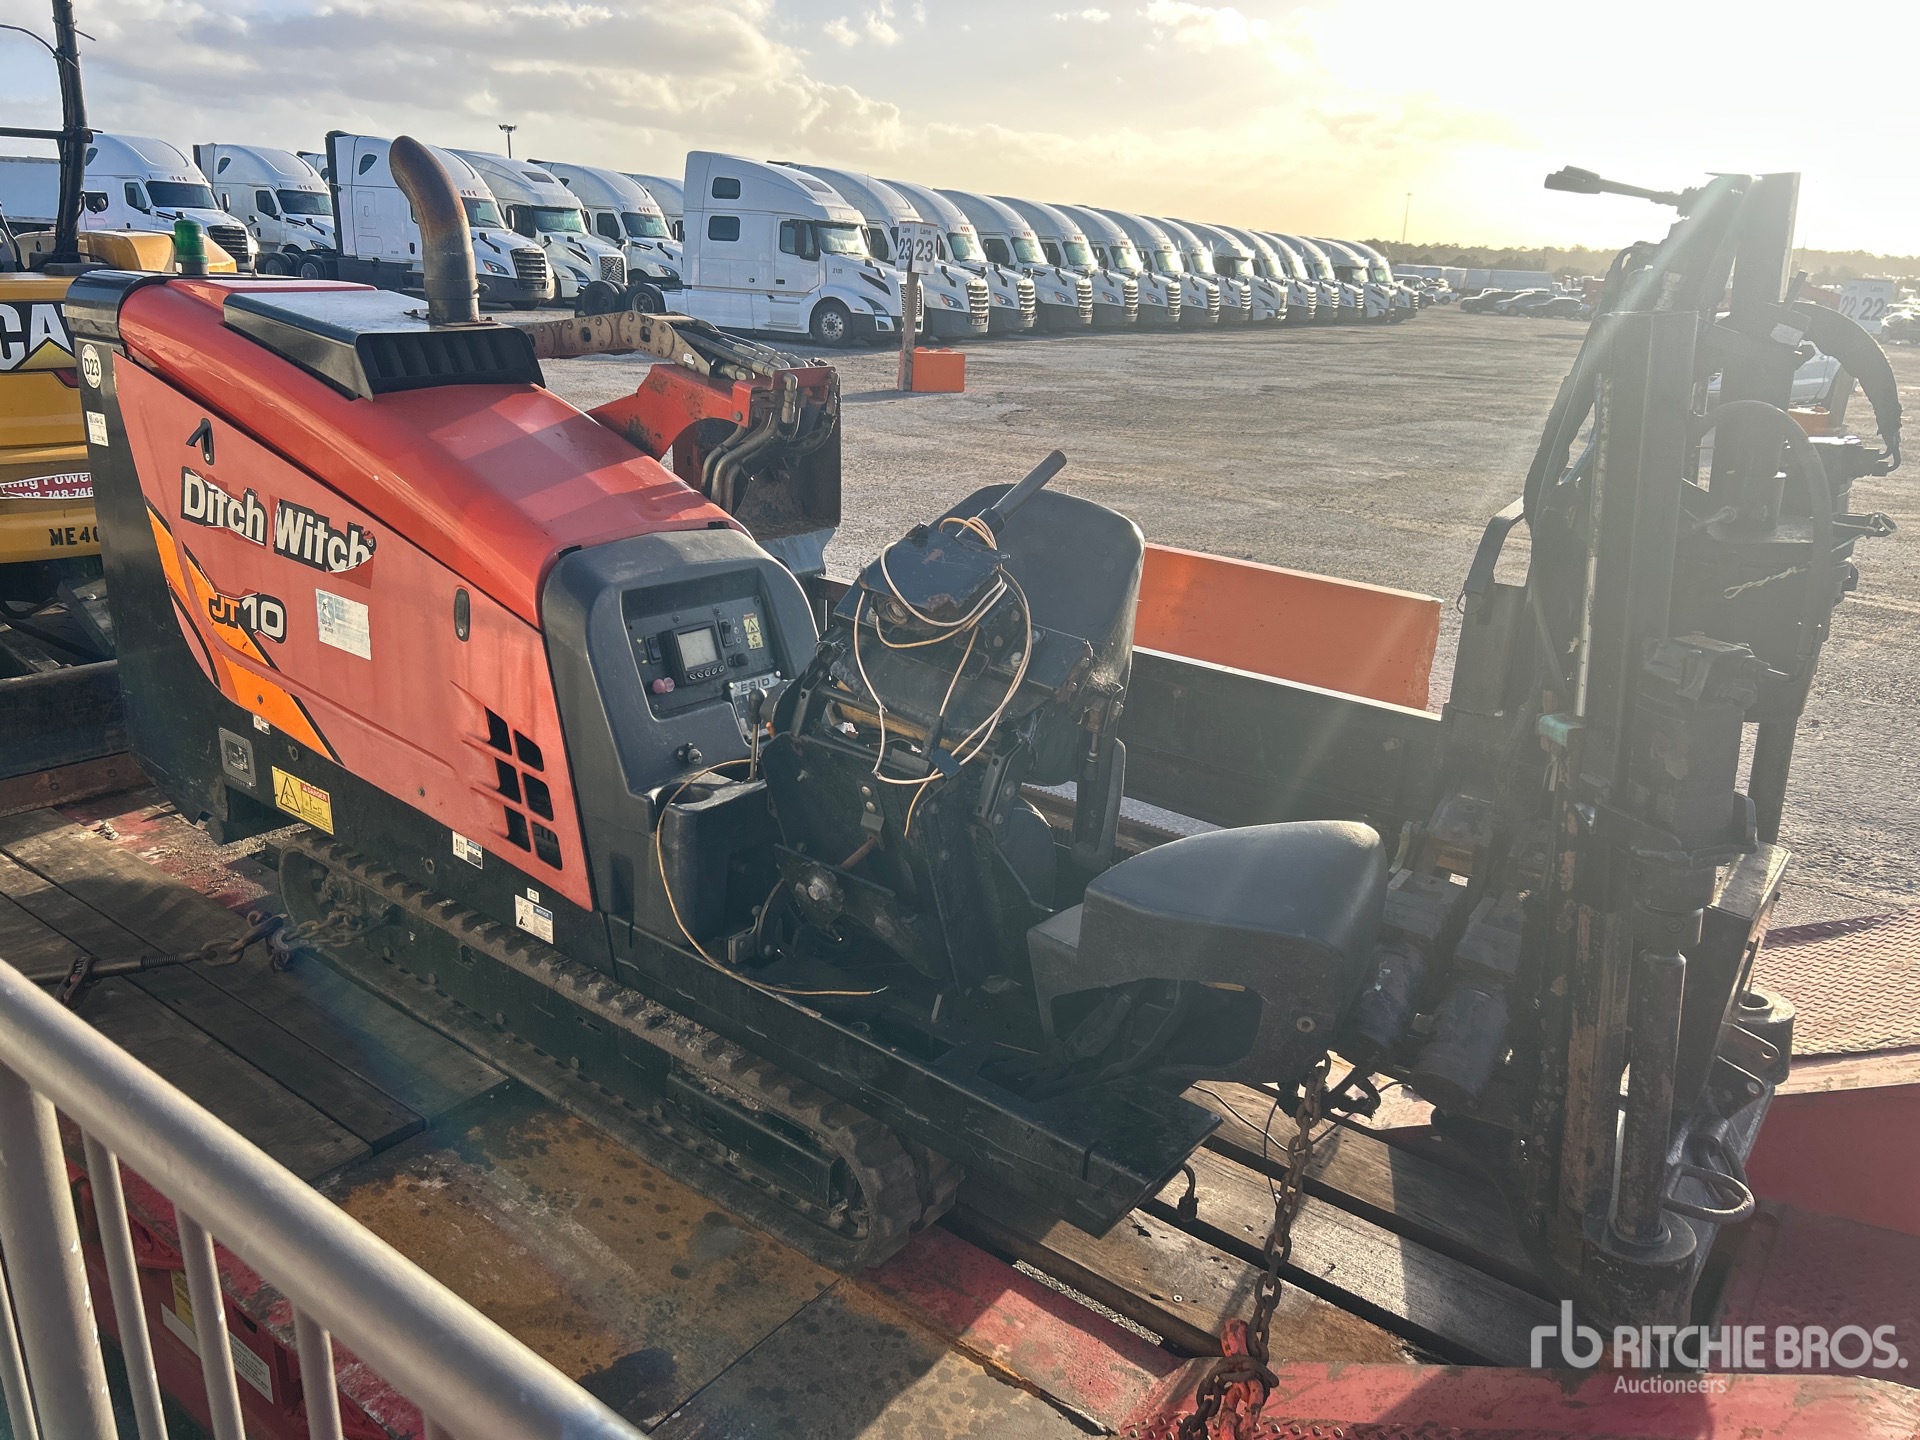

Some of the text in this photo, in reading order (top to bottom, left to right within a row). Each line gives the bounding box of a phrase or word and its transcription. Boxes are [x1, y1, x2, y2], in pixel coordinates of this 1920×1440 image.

[920, 227, 932, 235] Lane
[898, 237, 912, 260] 23
[915, 238, 934, 262] 23
[1858, 296, 1885, 321] 22
[0, 303, 73, 371] CA
[84, 358, 100, 376] D23
[183, 472, 372, 572] Ditch Witch
[211, 594, 284, 638] JT10
